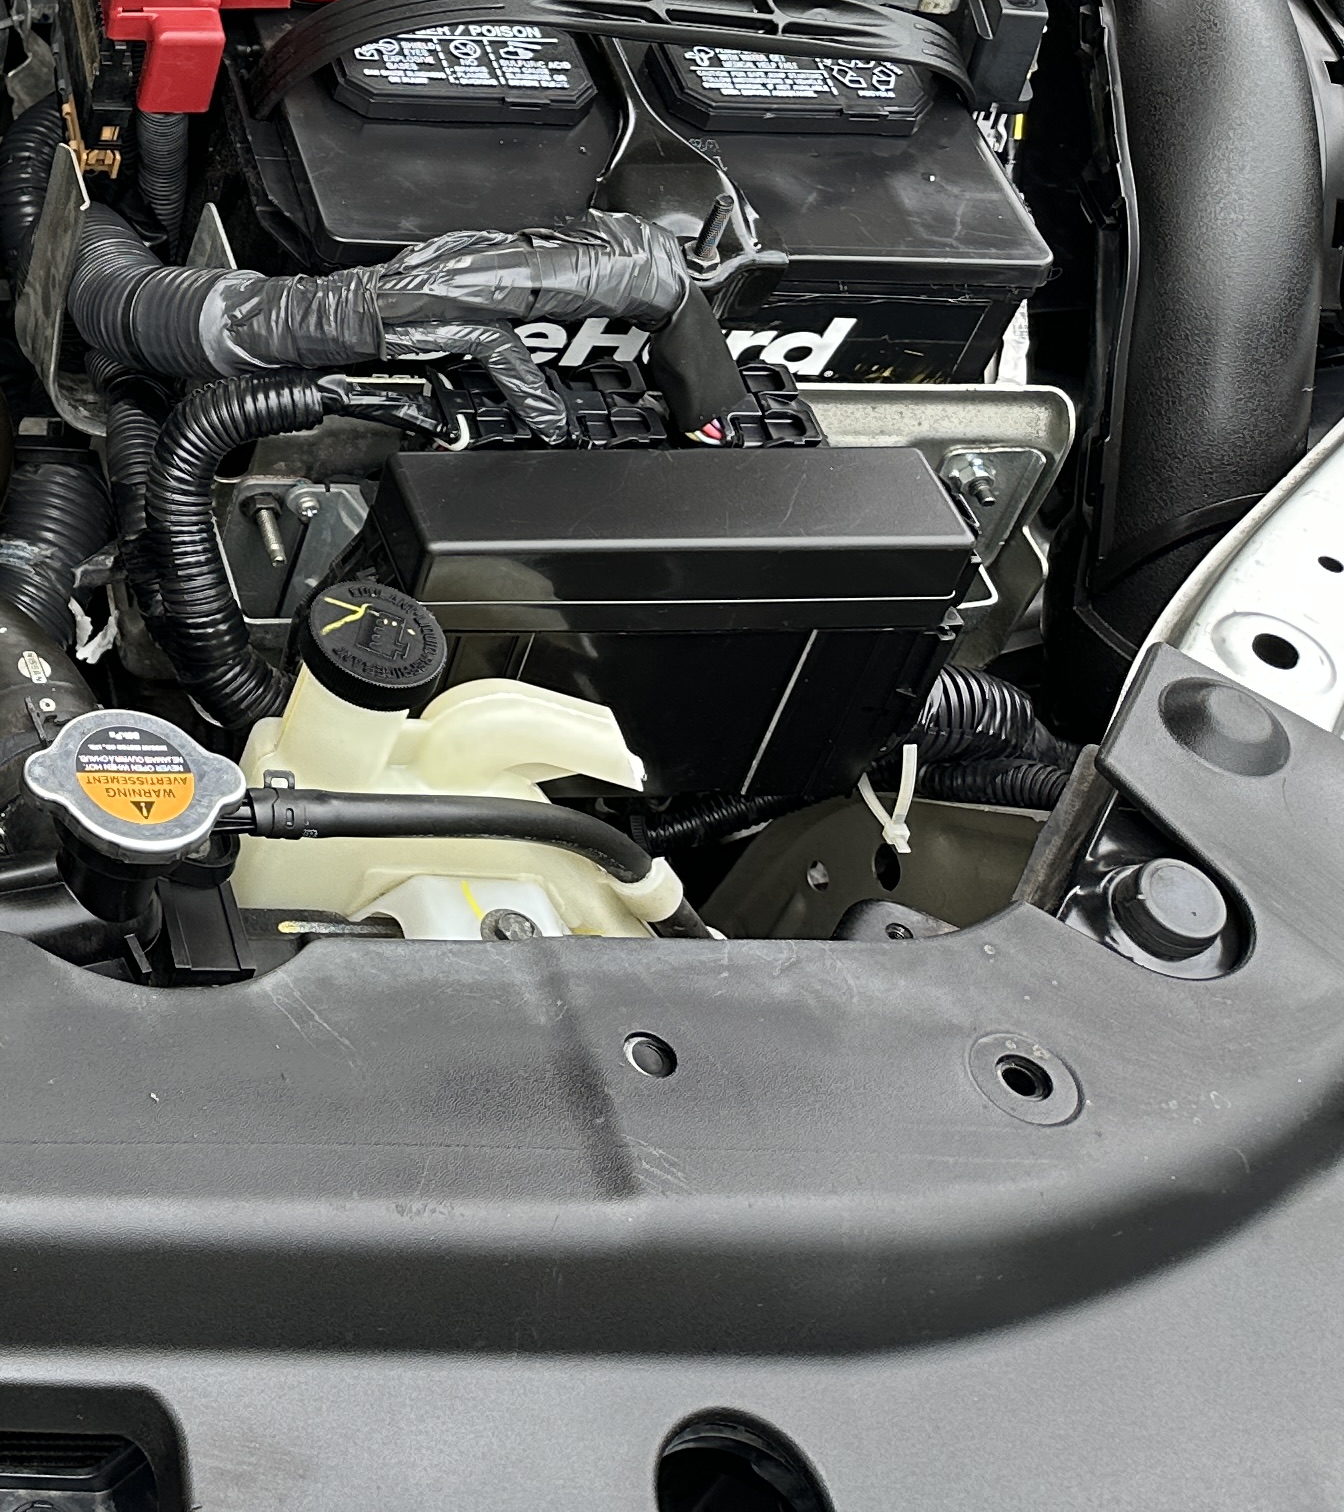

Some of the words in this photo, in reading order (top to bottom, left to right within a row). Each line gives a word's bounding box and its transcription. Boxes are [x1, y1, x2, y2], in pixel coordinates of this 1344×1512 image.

[469, 24, 542, 38] POISON
[103, 763, 130, 772] WHEN
[131, 764, 155, 772] OPEN
[155, 764, 184, 772] NEVER
[86, 775, 188, 786] AVERTISSEMENT
[105, 787, 177, 799] WARNING
